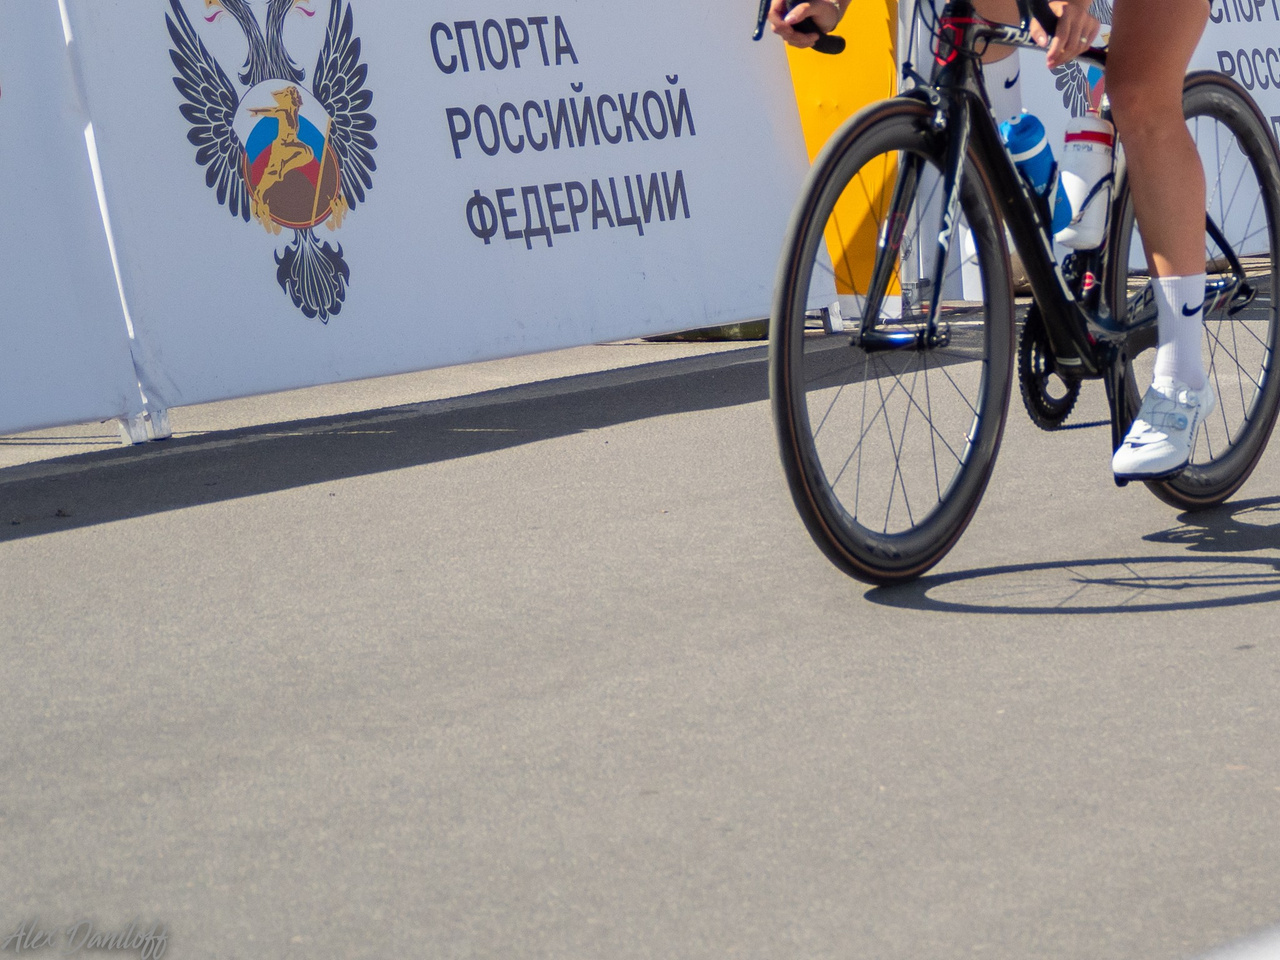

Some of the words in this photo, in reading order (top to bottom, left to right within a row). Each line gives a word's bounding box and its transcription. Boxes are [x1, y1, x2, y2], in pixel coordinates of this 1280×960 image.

[429, 15, 579, 75] СПОРТА
[445, 73, 697, 160] РОССИЙСКОЙ
[465, 169, 691, 251] ФЕДЕРАЦИИ
